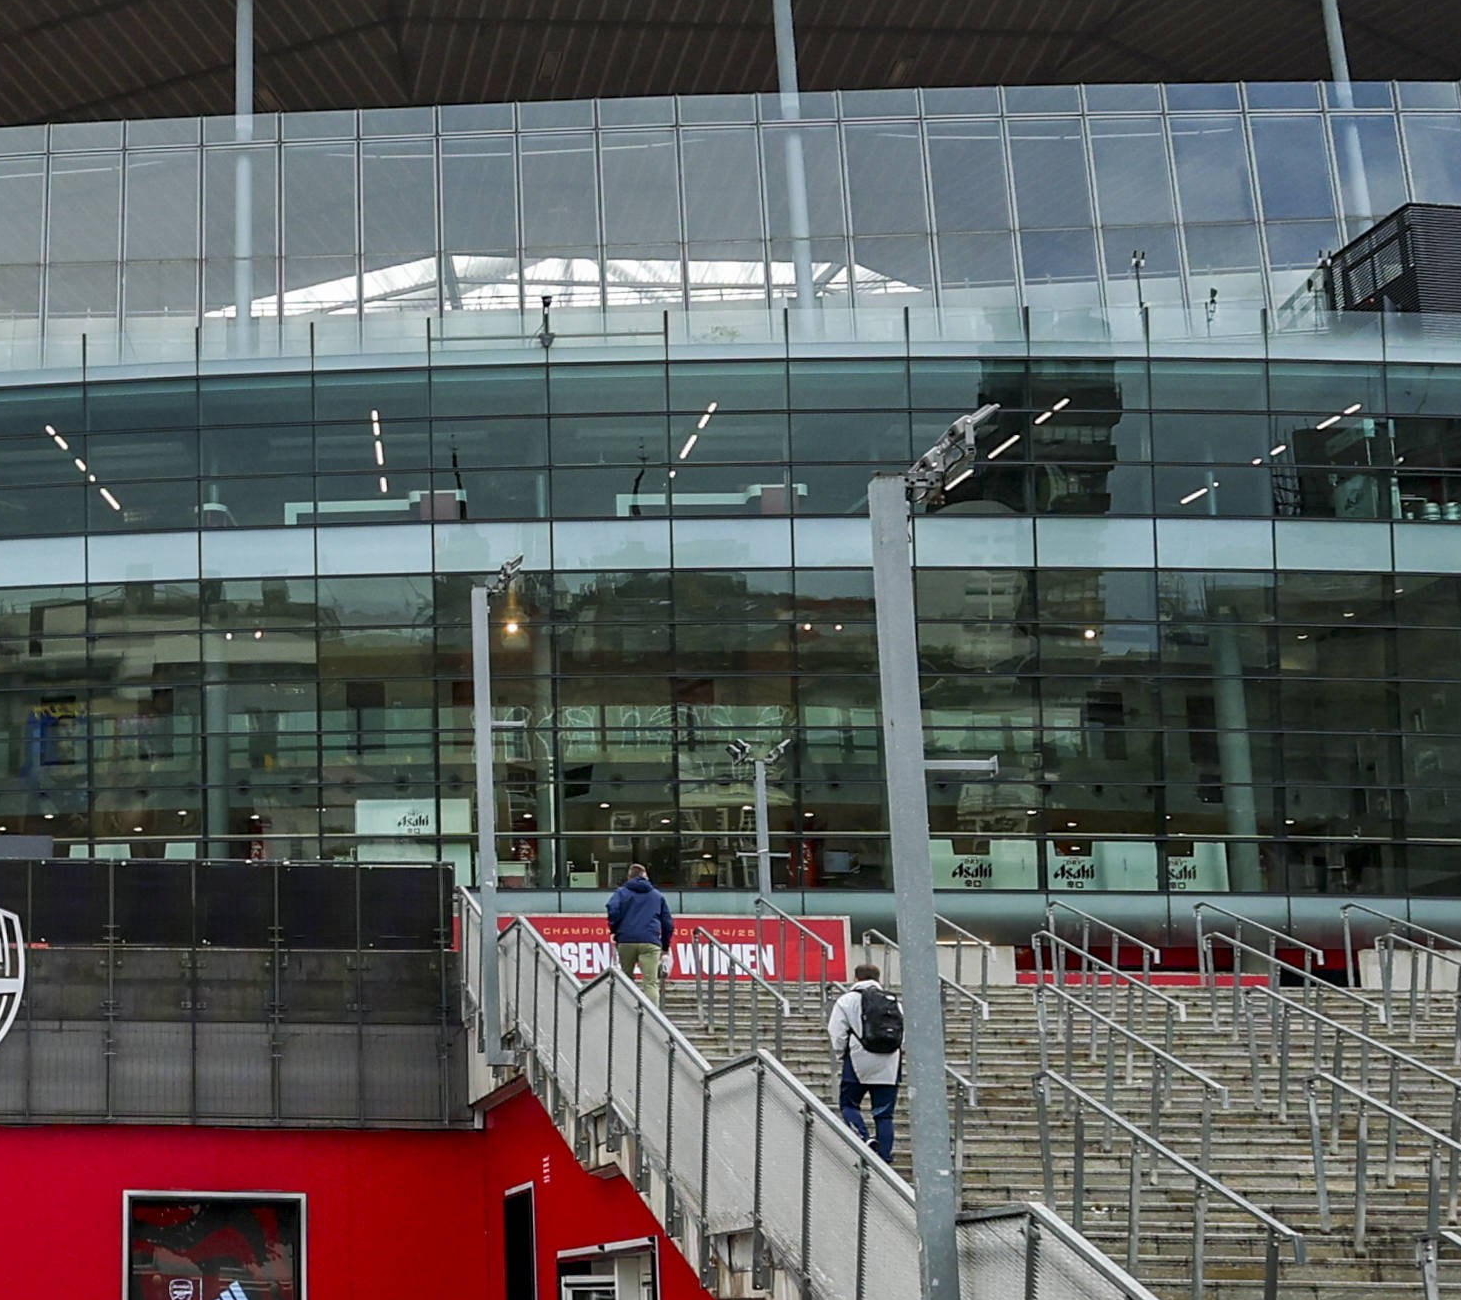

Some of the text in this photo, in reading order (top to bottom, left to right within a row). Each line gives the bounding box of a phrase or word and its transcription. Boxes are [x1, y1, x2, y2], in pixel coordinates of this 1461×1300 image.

[951, 861, 993, 879] Asahi
[1053, 862, 1095, 880] Asahi
[543, 926, 612, 936] CHAMPION
[677, 942, 775, 976] WOMEN
